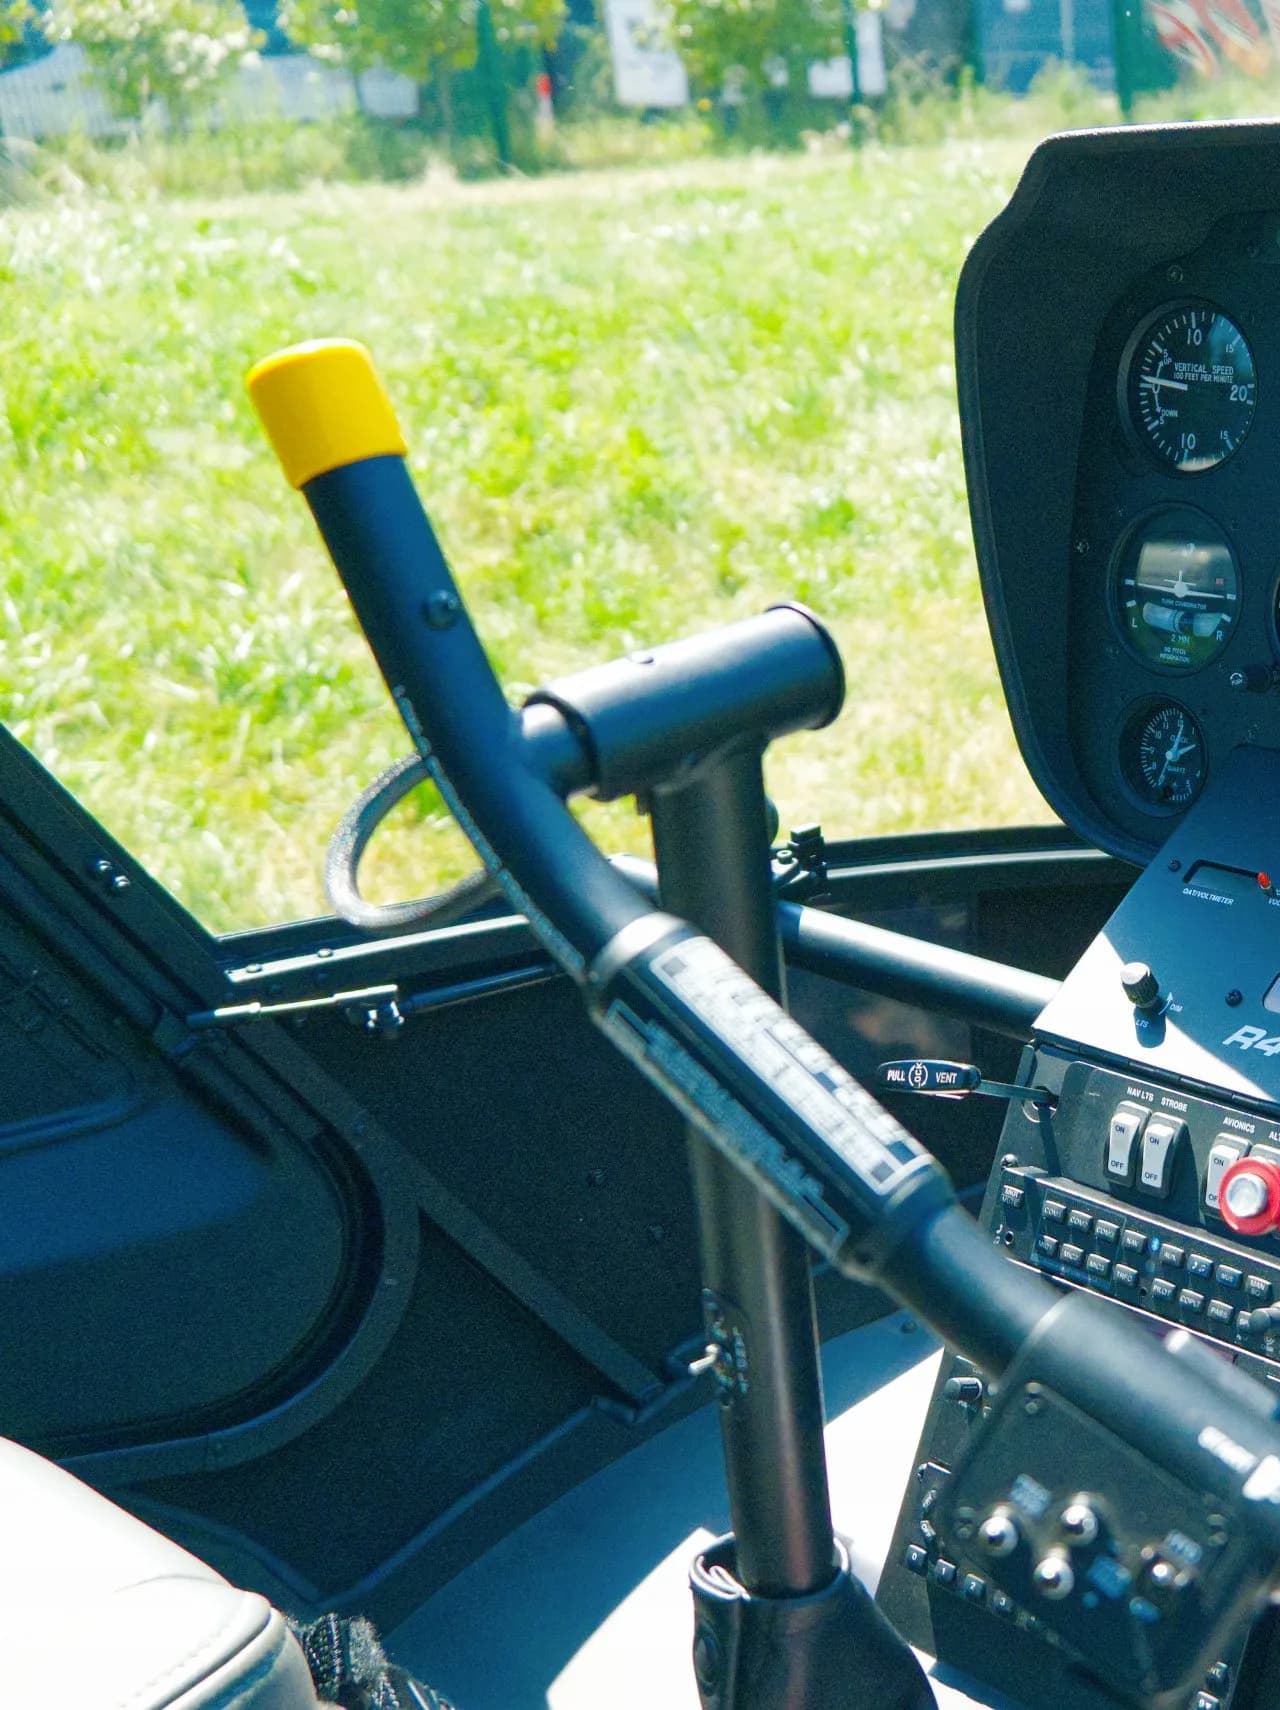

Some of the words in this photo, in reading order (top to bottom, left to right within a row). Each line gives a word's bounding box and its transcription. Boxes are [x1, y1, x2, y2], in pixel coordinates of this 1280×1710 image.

[1187, 329, 1202, 345] 10
[1175, 362, 1206, 373] VERTICAL
[1212, 365, 1233, 375] SPEED
[1201, 374, 1212, 382] PER
[1213, 375, 1233, 383] MINUTE
[1230, 385, 1247, 402] 20
[1161, 409, 1178, 417] DOWN
[1181, 433, 1196, 449] 10
[1220, 431, 1228, 440] 15
[887, 1070, 905, 1082] PULL
[936, 1072, 957, 1083] VENT
[1127, 1086, 1141, 1097] NAV
[1141, 1090, 1154, 1102] LTS
[1160, 1096, 1188, 1112] STROBE
[1114, 1124, 1125, 1134] ON
[1223, 1116, 1255, 1134] AVIONICS
[1150, 1136, 1160, 1146] ON
[1110, 1160, 1124, 1170] OFF
[1144, 1171, 1158, 1182] OFF
